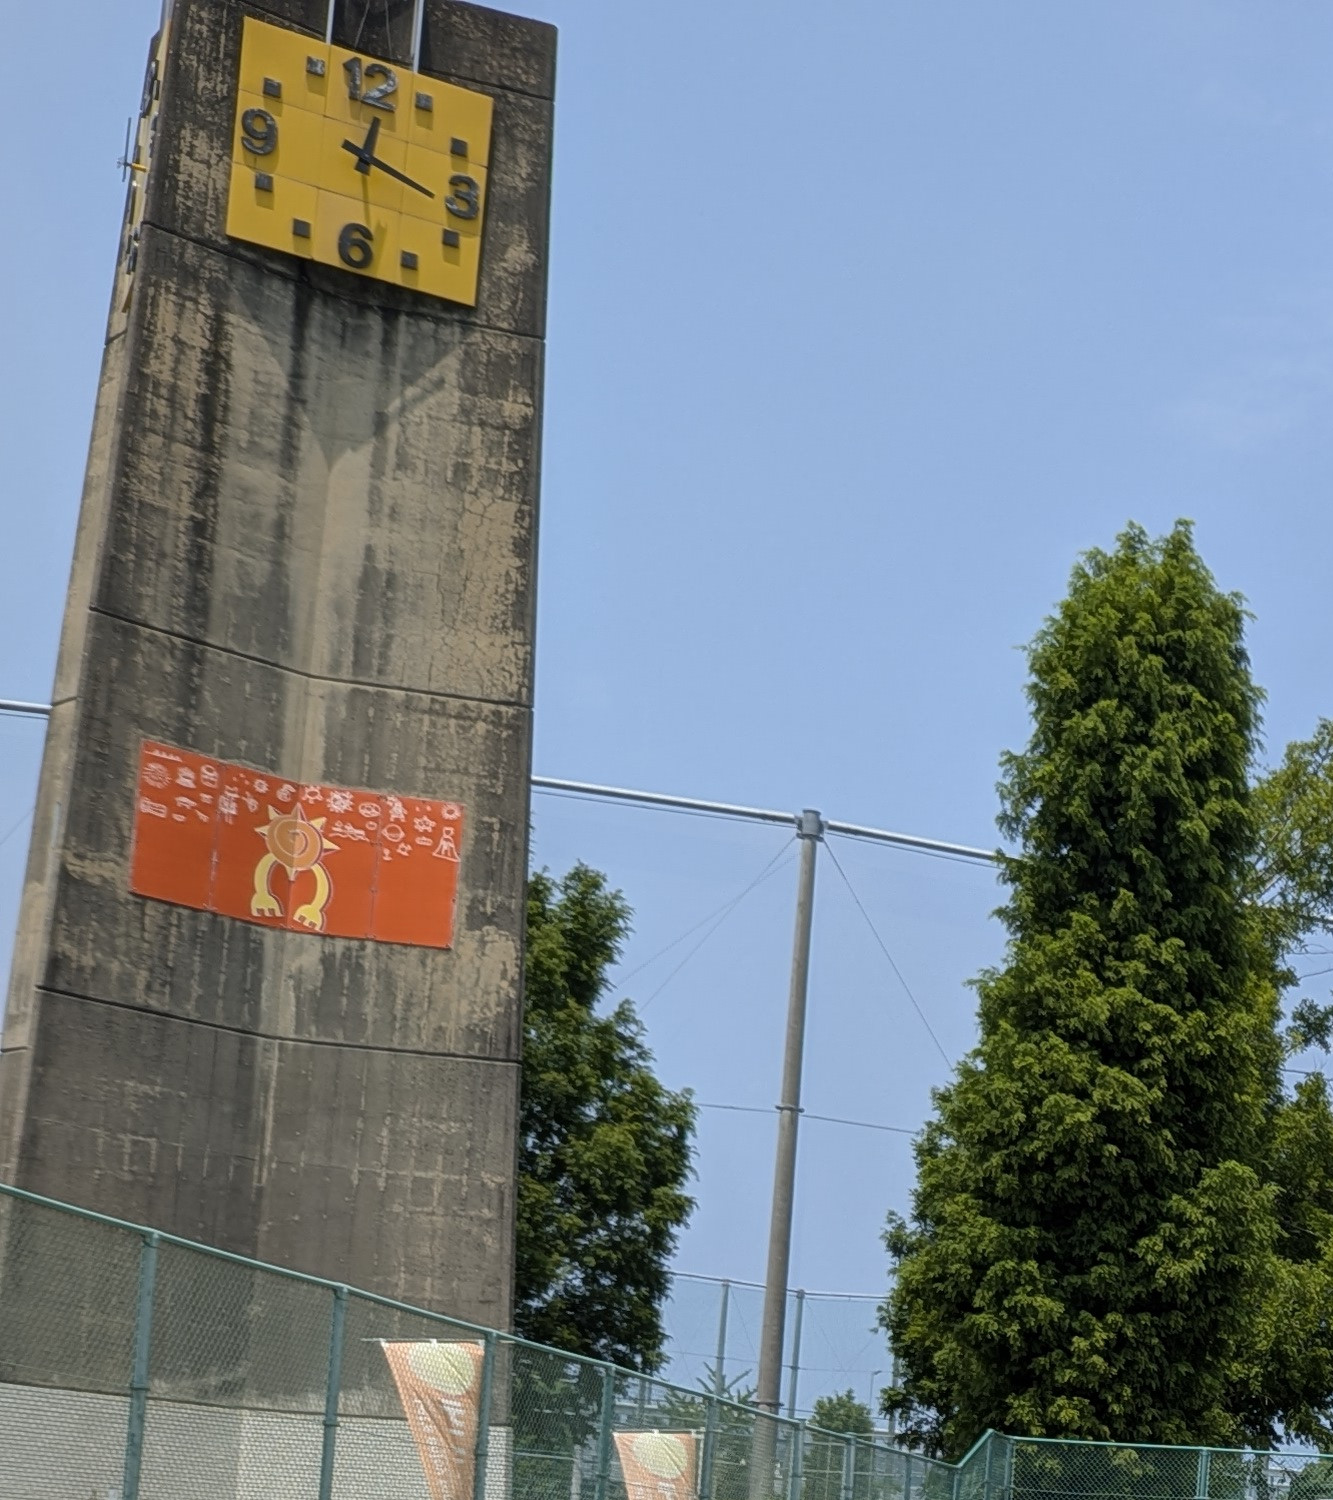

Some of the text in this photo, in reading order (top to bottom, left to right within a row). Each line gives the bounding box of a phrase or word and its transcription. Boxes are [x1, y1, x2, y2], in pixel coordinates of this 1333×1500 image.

[342, 56, 398, 113] 12
[240, 108, 279, 156] 9
[444, 174, 480, 220] 3
[337, 222, 374, 269] 6
